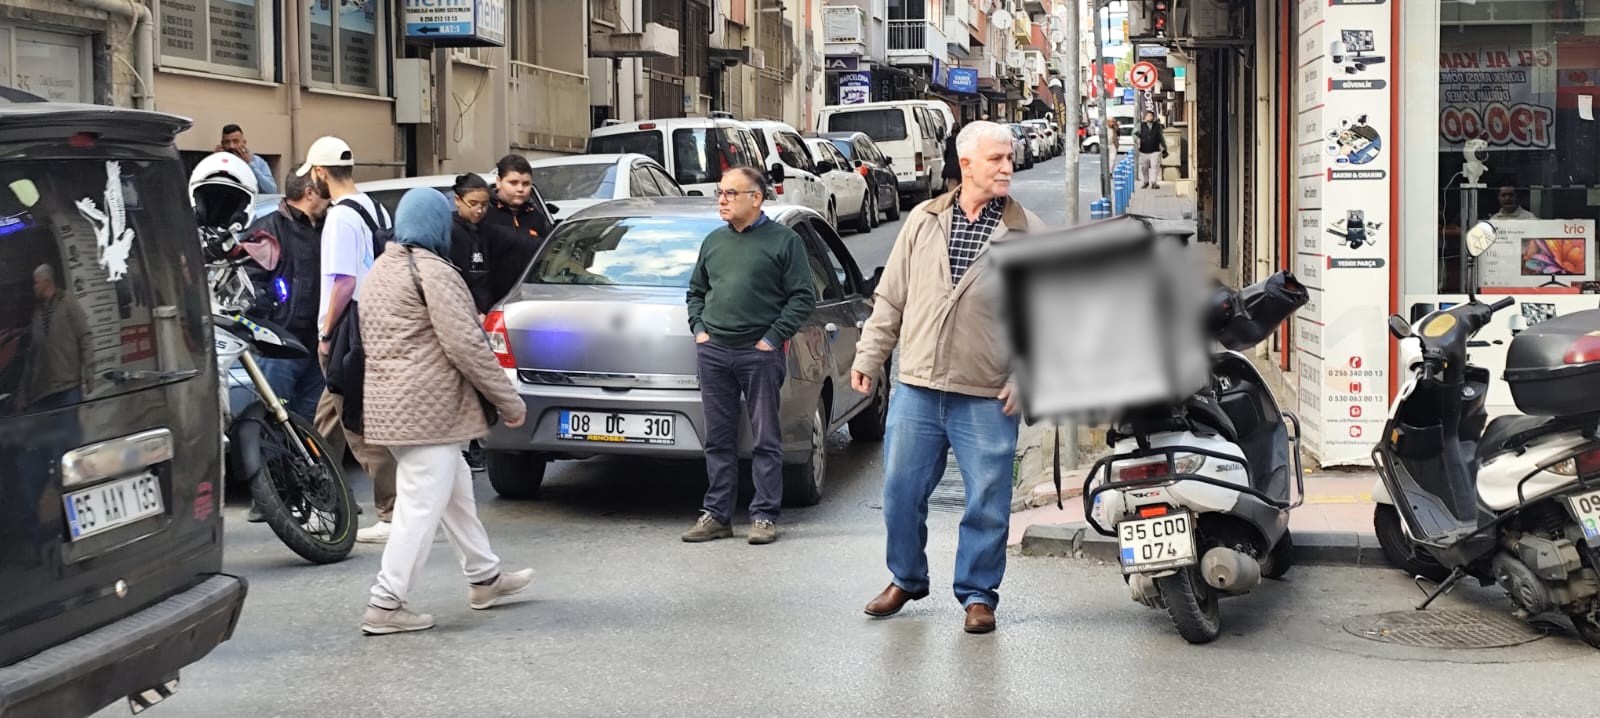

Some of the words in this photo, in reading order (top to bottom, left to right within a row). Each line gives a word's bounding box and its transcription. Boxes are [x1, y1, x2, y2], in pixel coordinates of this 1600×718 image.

[439, 25, 460, 33] KAT:1
[1342, 80, 1372, 89] GÜVENLİK
[1563, 223, 1585, 235] trio
[1357, 260, 1377, 268] PARÇA
[571, 414, 590, 433] 08
[606, 415, 625, 434] DC
[644, 418, 671, 436] 310
[102, 484, 128, 522] AAY
[132, 476, 157, 513] 135
[1123, 523, 1147, 541] 35
[1142, 542, 1177, 560] 074
